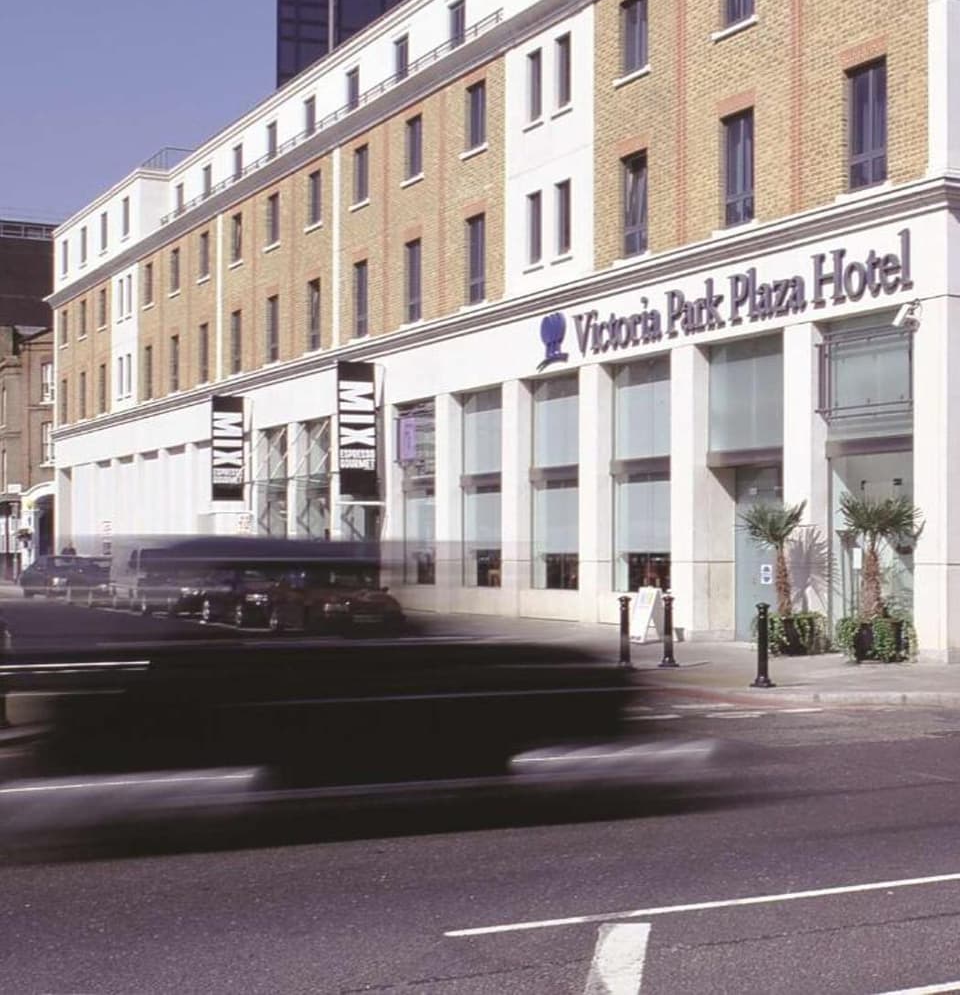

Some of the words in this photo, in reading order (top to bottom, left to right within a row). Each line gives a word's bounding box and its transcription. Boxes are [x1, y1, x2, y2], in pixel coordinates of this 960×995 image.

[572, 297, 662, 358] Victoria
[665, 277, 726, 339] Park
[727, 266, 807, 326] Plaza
[810, 228, 914, 308] Hotel
[212, 412, 243, 466] MIX
[339, 380, 376, 446] MIX
